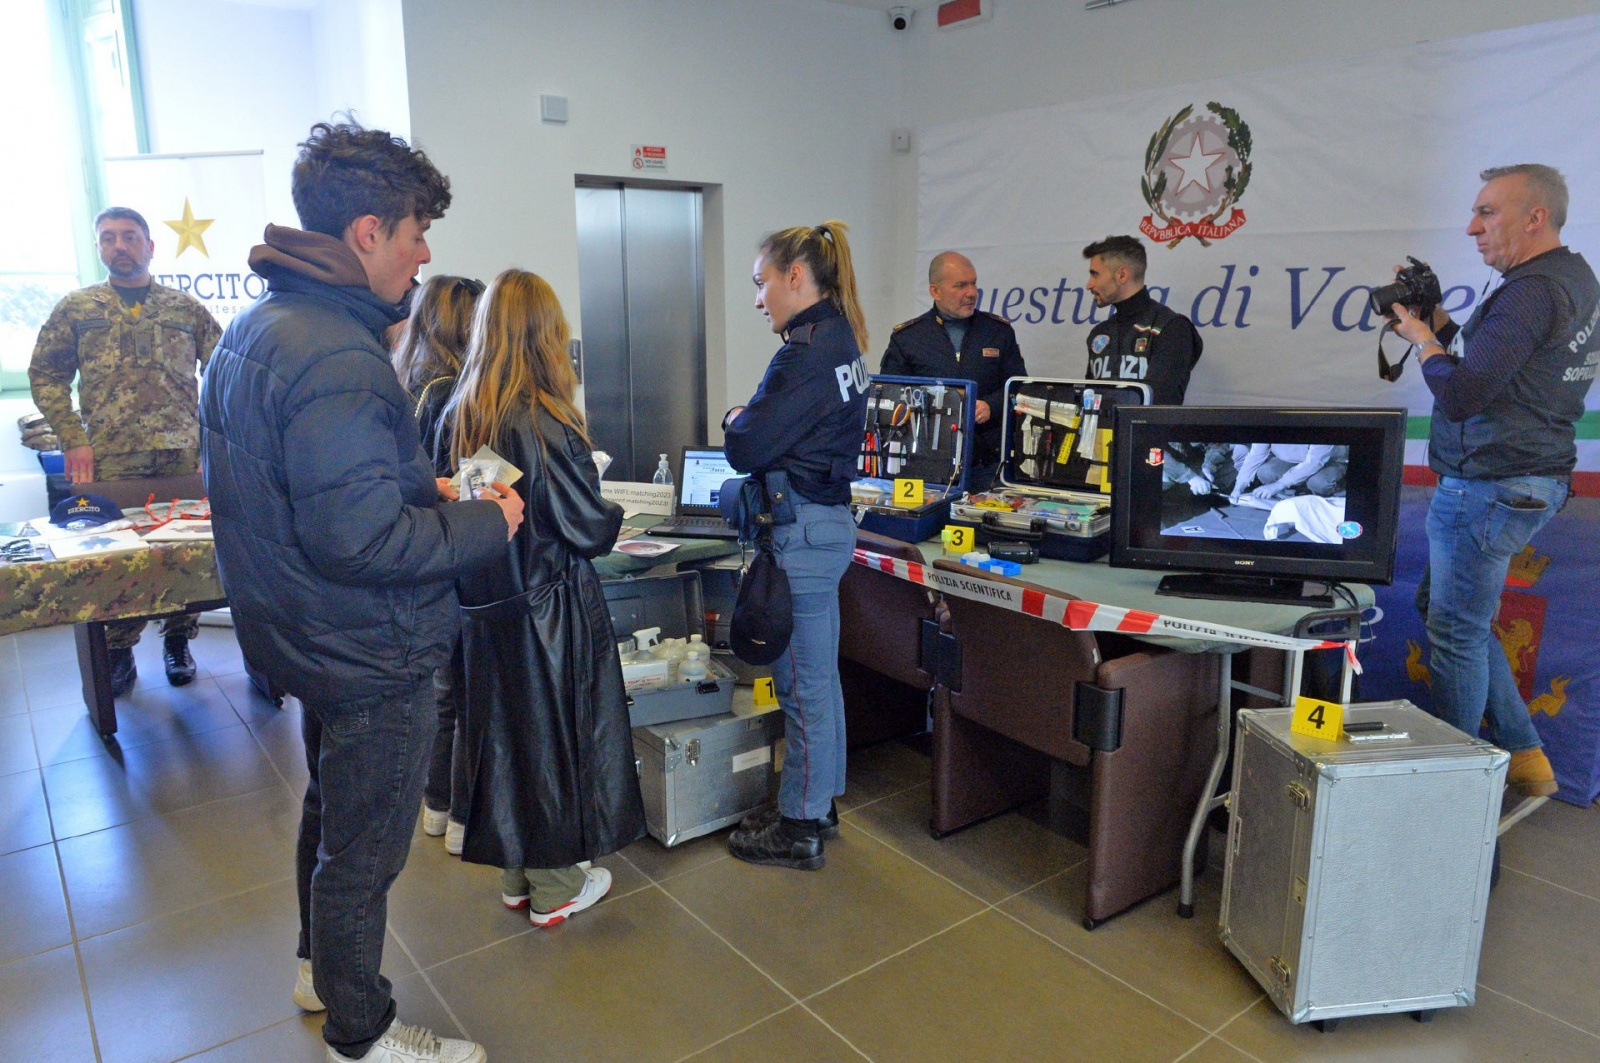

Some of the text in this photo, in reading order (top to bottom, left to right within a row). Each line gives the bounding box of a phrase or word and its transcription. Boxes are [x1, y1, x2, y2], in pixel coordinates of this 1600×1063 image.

[1140, 216, 1245, 240] REPVBBLICA ITALIANA
[151, 272, 266, 300] ERCITO
[976, 277, 1171, 326] uestua
[1190, 264, 1260, 329] di
[1090, 354, 1149, 380] OLIZI
[903, 481, 915, 498] 2
[951, 529, 964, 547] 3
[1234, 559, 1256, 567] SONY
[927, 571, 1013, 602] POLIZIA SCIENTIFICA
[765, 680, 774, 698] 1
[1307, 704, 1325, 730] 4
